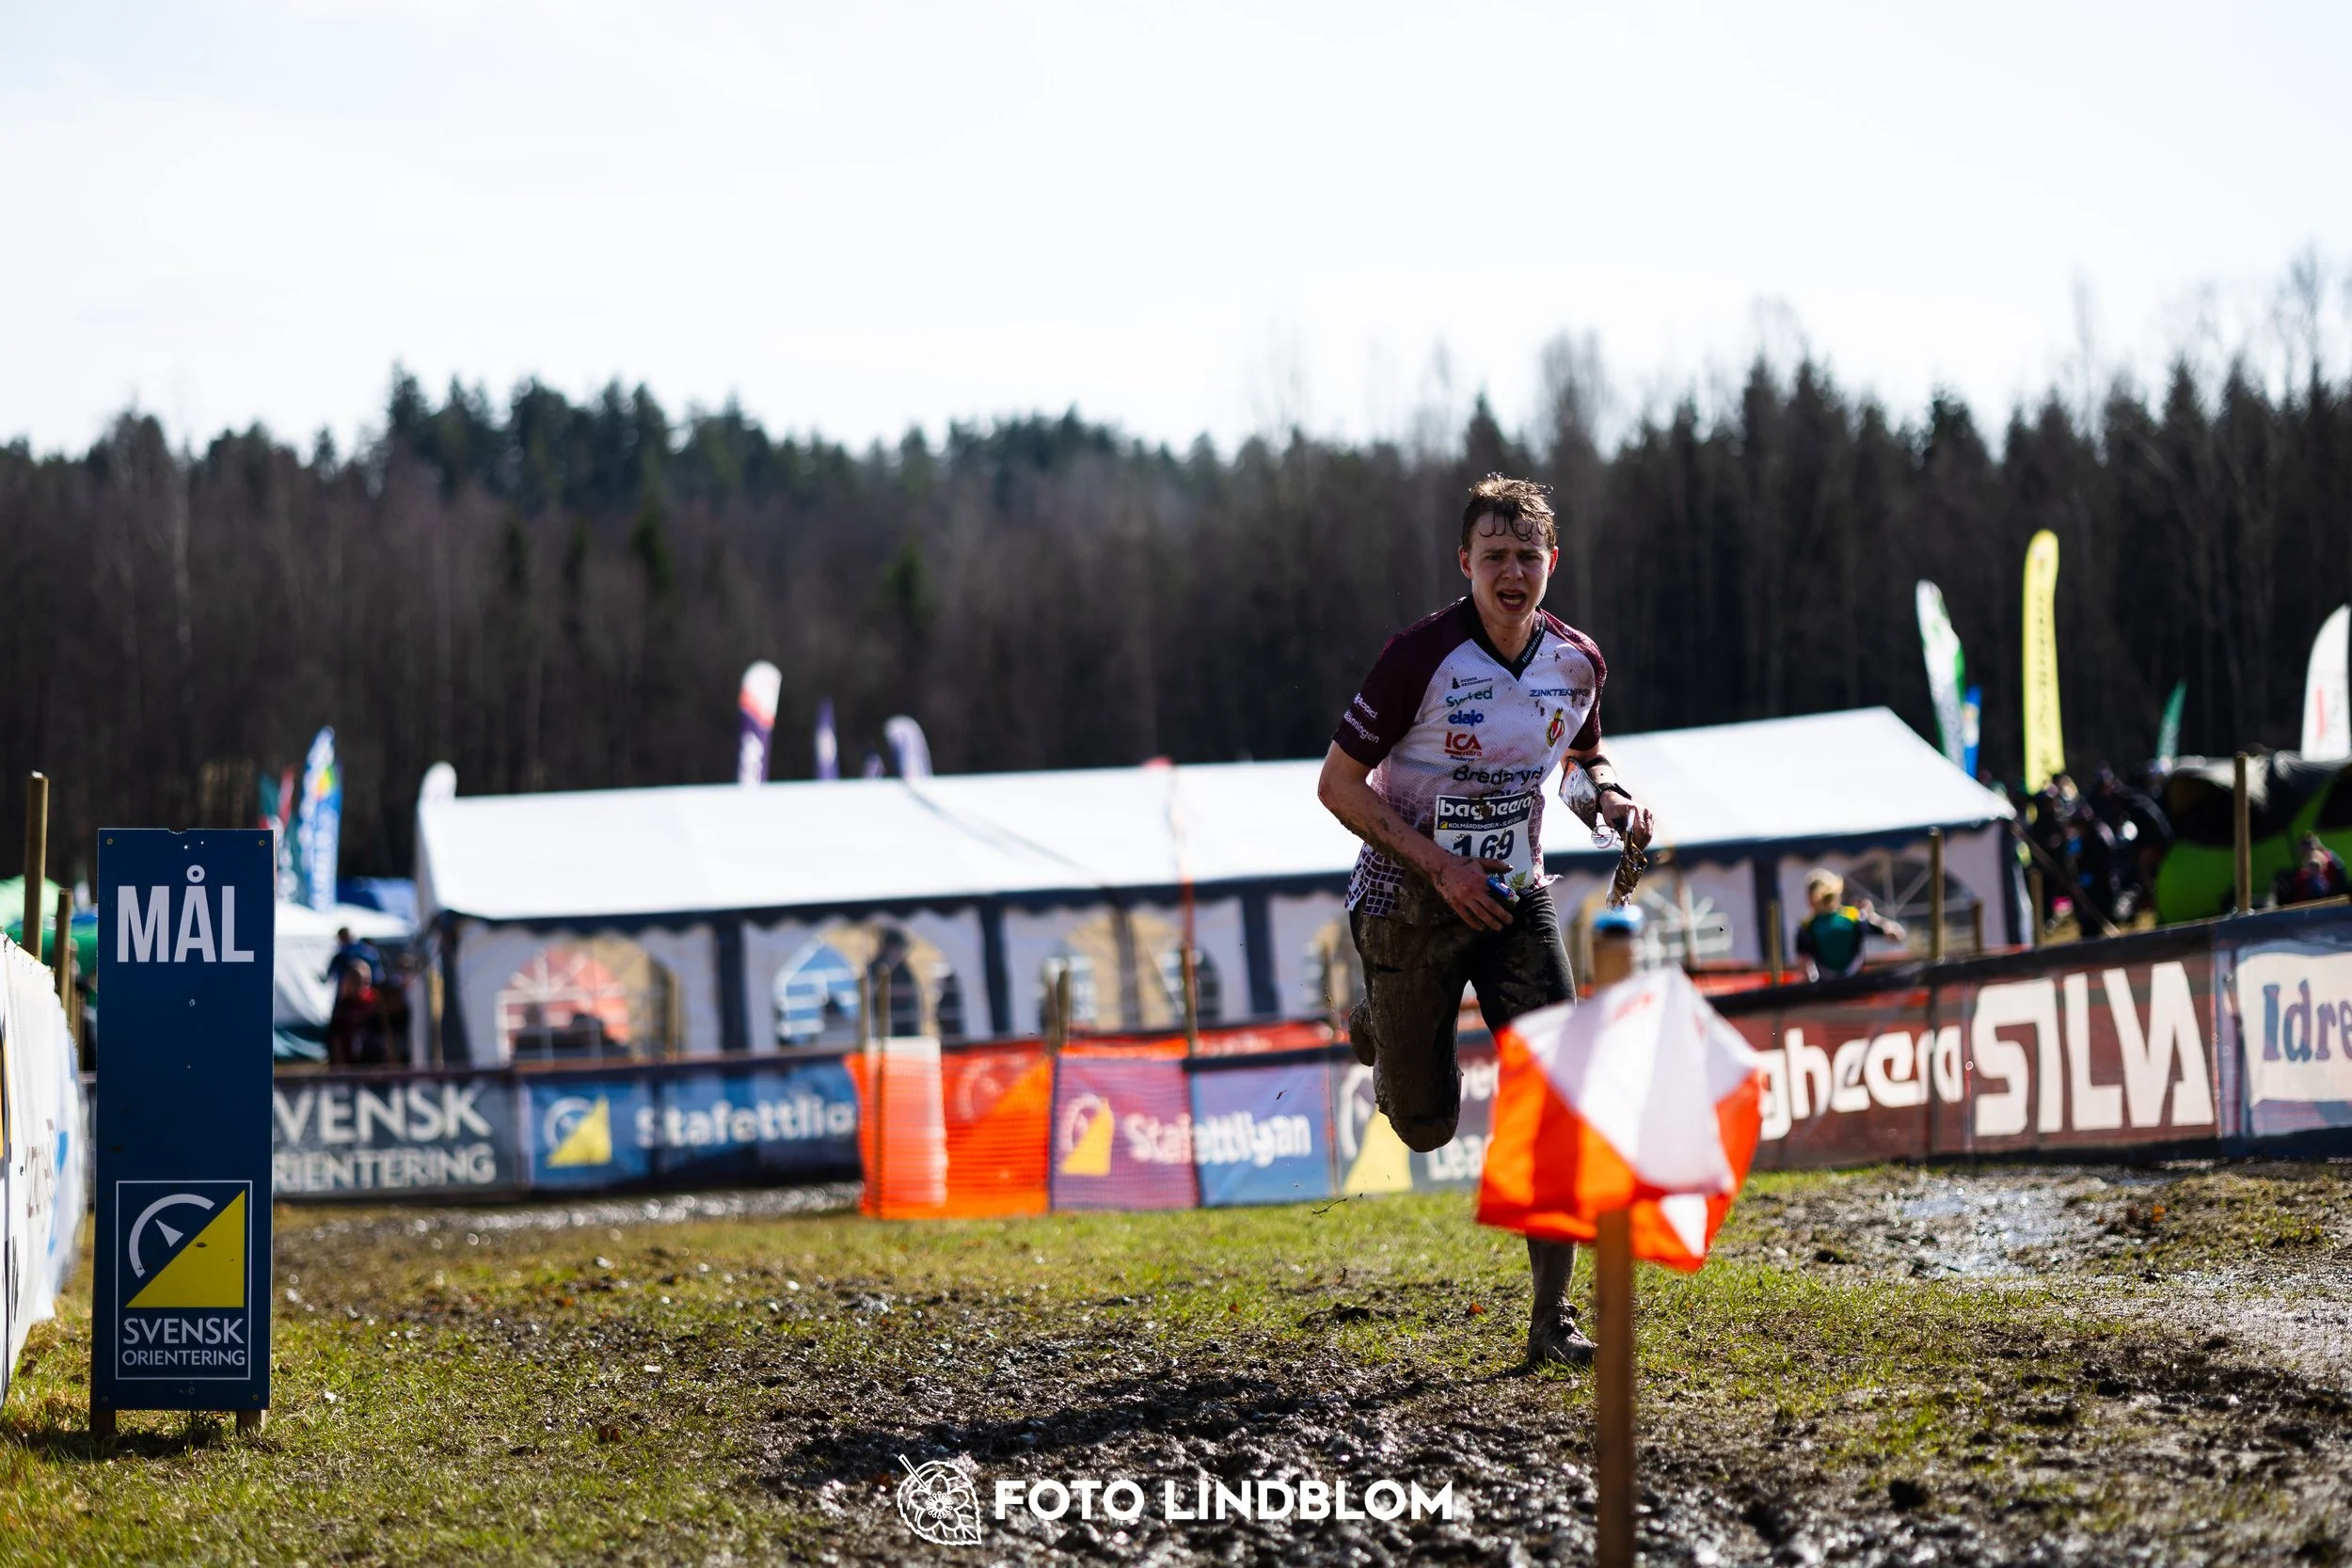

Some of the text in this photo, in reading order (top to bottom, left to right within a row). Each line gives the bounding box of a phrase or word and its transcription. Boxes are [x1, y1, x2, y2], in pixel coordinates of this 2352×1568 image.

[1448, 709, 1485, 726] elajo
[1445, 731, 1483, 751] ICA
[1453, 829, 1515, 860] 169
[117, 864, 255, 963] MÅL
[1973, 961, 2216, 1136] SILVA
[1760, 1028, 1963, 1141] gheera
[272, 1082, 492, 1145] VENSK
[272, 1141, 498, 1192] RIENTERING
[123, 1318, 245, 1345] SVENSK
[122, 1350, 246, 1366] ORIENTERING
